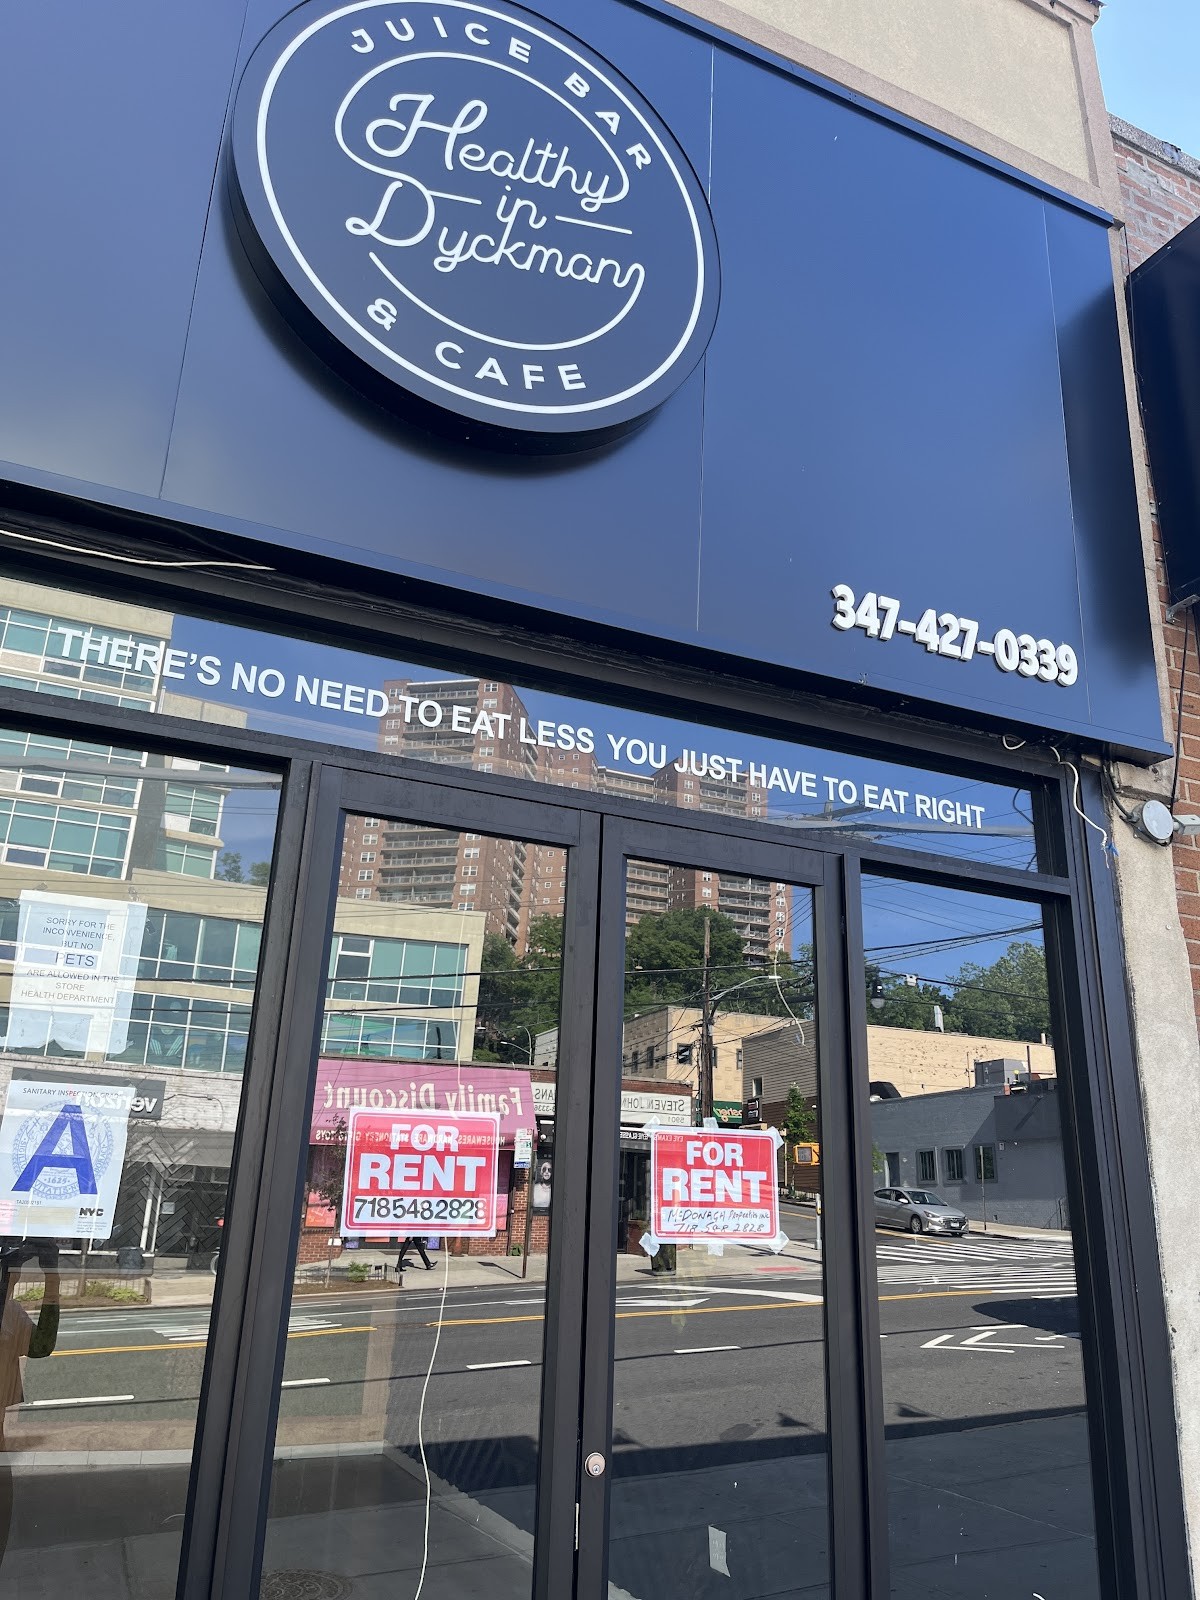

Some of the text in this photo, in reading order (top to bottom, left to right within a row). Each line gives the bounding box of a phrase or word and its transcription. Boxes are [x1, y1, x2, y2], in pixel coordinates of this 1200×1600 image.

[350, 16, 651, 170] JUICE BAR
[365, 93, 629, 213] Healthy
[495, 185, 547, 231] in
[345, 181, 645, 288] Dyckman
[366, 298, 587, 390] & CAFE
[831, 583, 1078, 687] 347-427-0339
[57, 627, 985, 829] THERE'S NO NEED TO EAT LESS YOU JUST HAVE TO EAT RIGHT
[46, 916, 116, 931] SORRY FOR THE
[56, 952, 95, 967] PETS
[61, 940, 94, 950] BUT NO
[26, 969, 119, 984] ARE ALLOWED IN THE
[55, 982, 85, 991] STORE
[20, 990, 115, 1004] HEALTH DEPARTMENT
[23, 1087, 57, 1096] SANITARY
[11, 1104, 98, 1195] A
[390, 1123, 459, 1152] FOR
[686, 1140, 744, 1167] FOR
[357, 1153, 486, 1192] RENT
[662, 1168, 767, 1203] RENT
[79, 1207, 104, 1217] NYC
[354, 1197, 487, 1221] 7185482828
